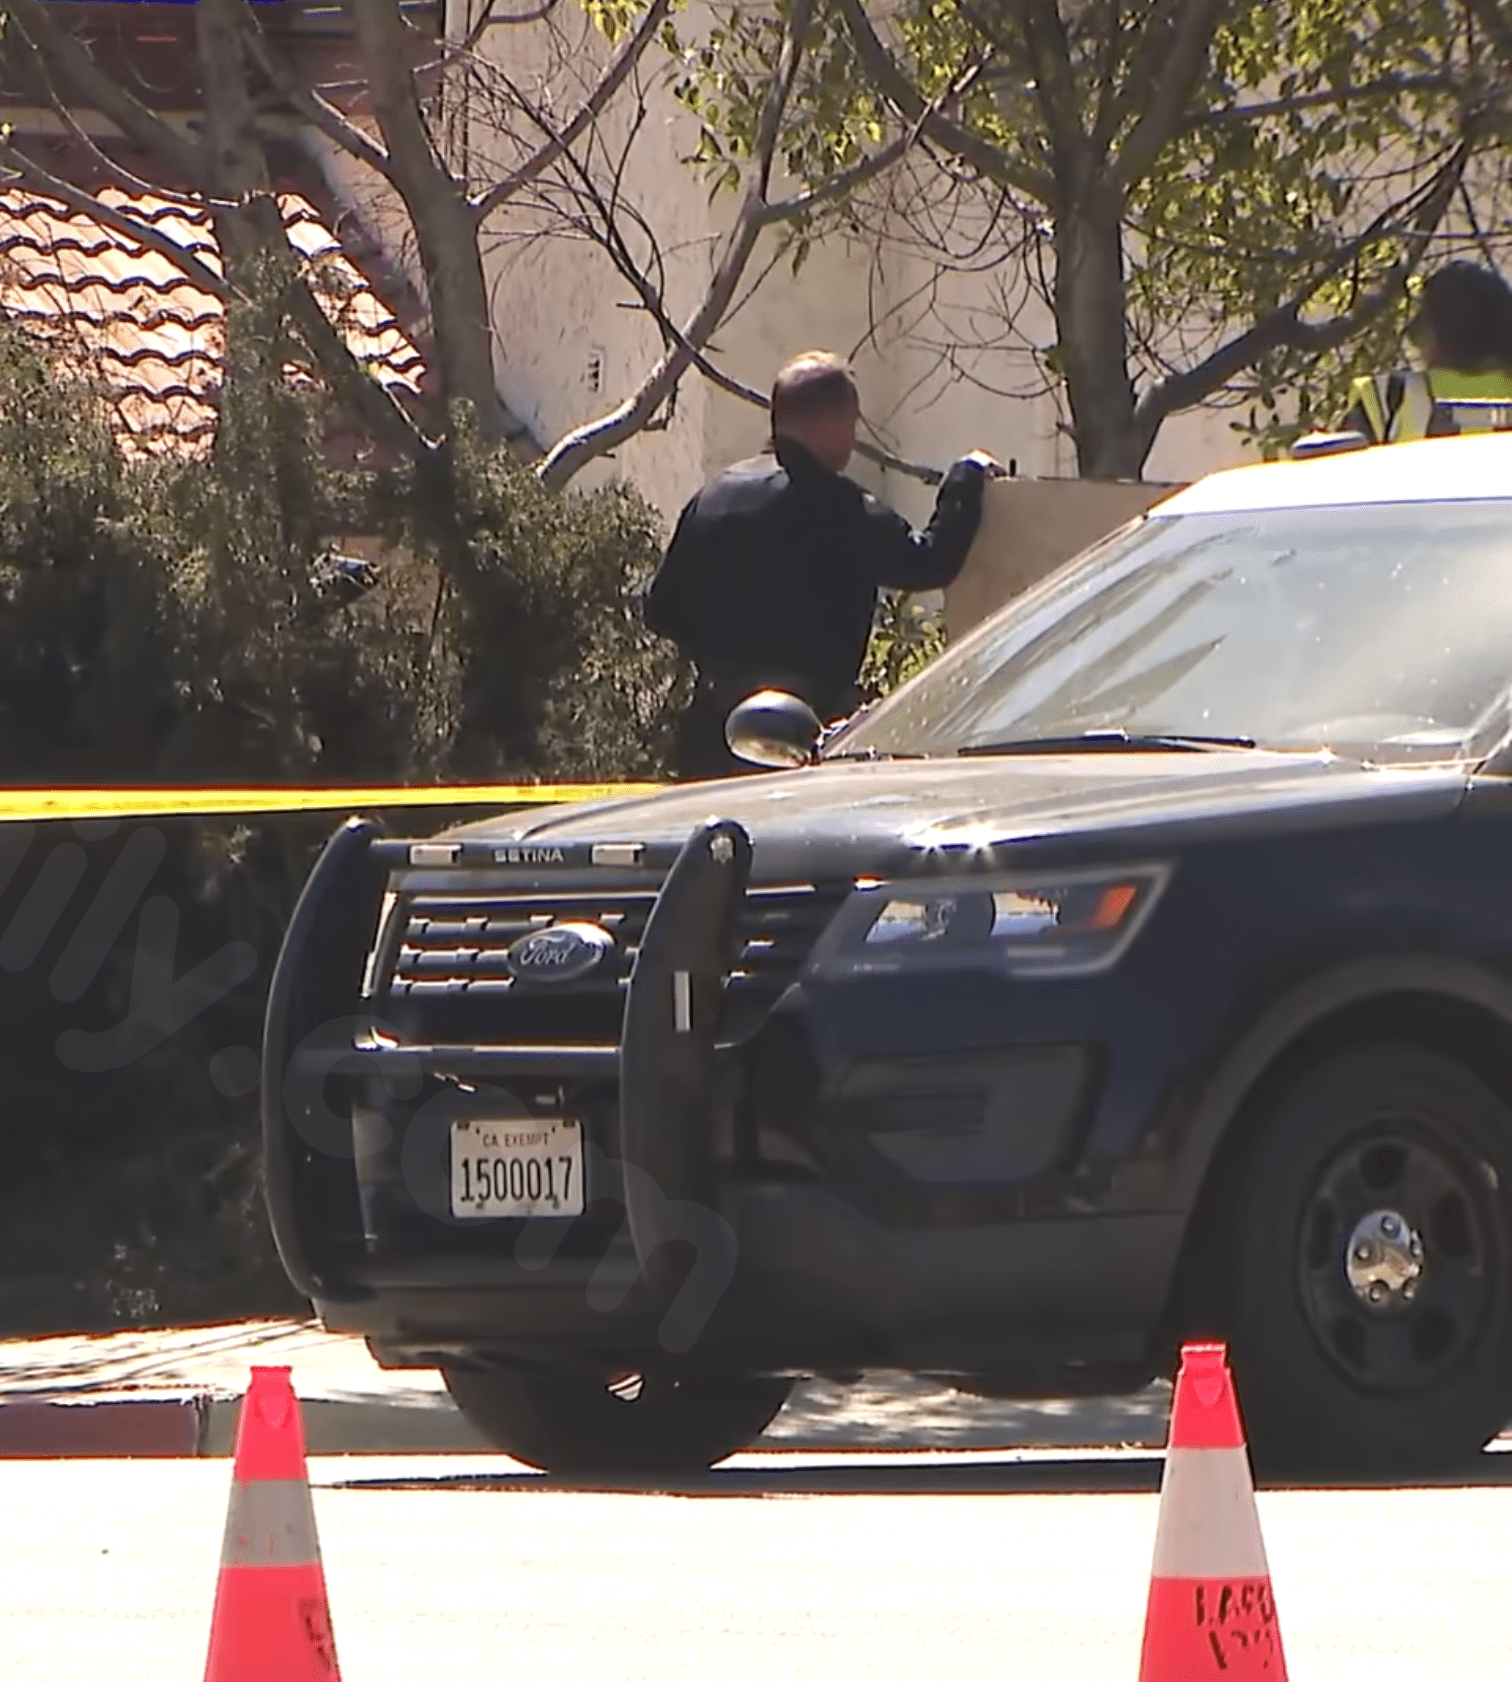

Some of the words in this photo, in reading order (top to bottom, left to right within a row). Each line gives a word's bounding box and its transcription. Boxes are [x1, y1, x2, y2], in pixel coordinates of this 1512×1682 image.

[494, 848, 565, 863] SETINA
[519, 934, 578, 967] Ford
[482, 1133, 500, 1148] CA
[504, 1132, 551, 1148] EXEMPT
[460, 1156, 574, 1203] 1500017
